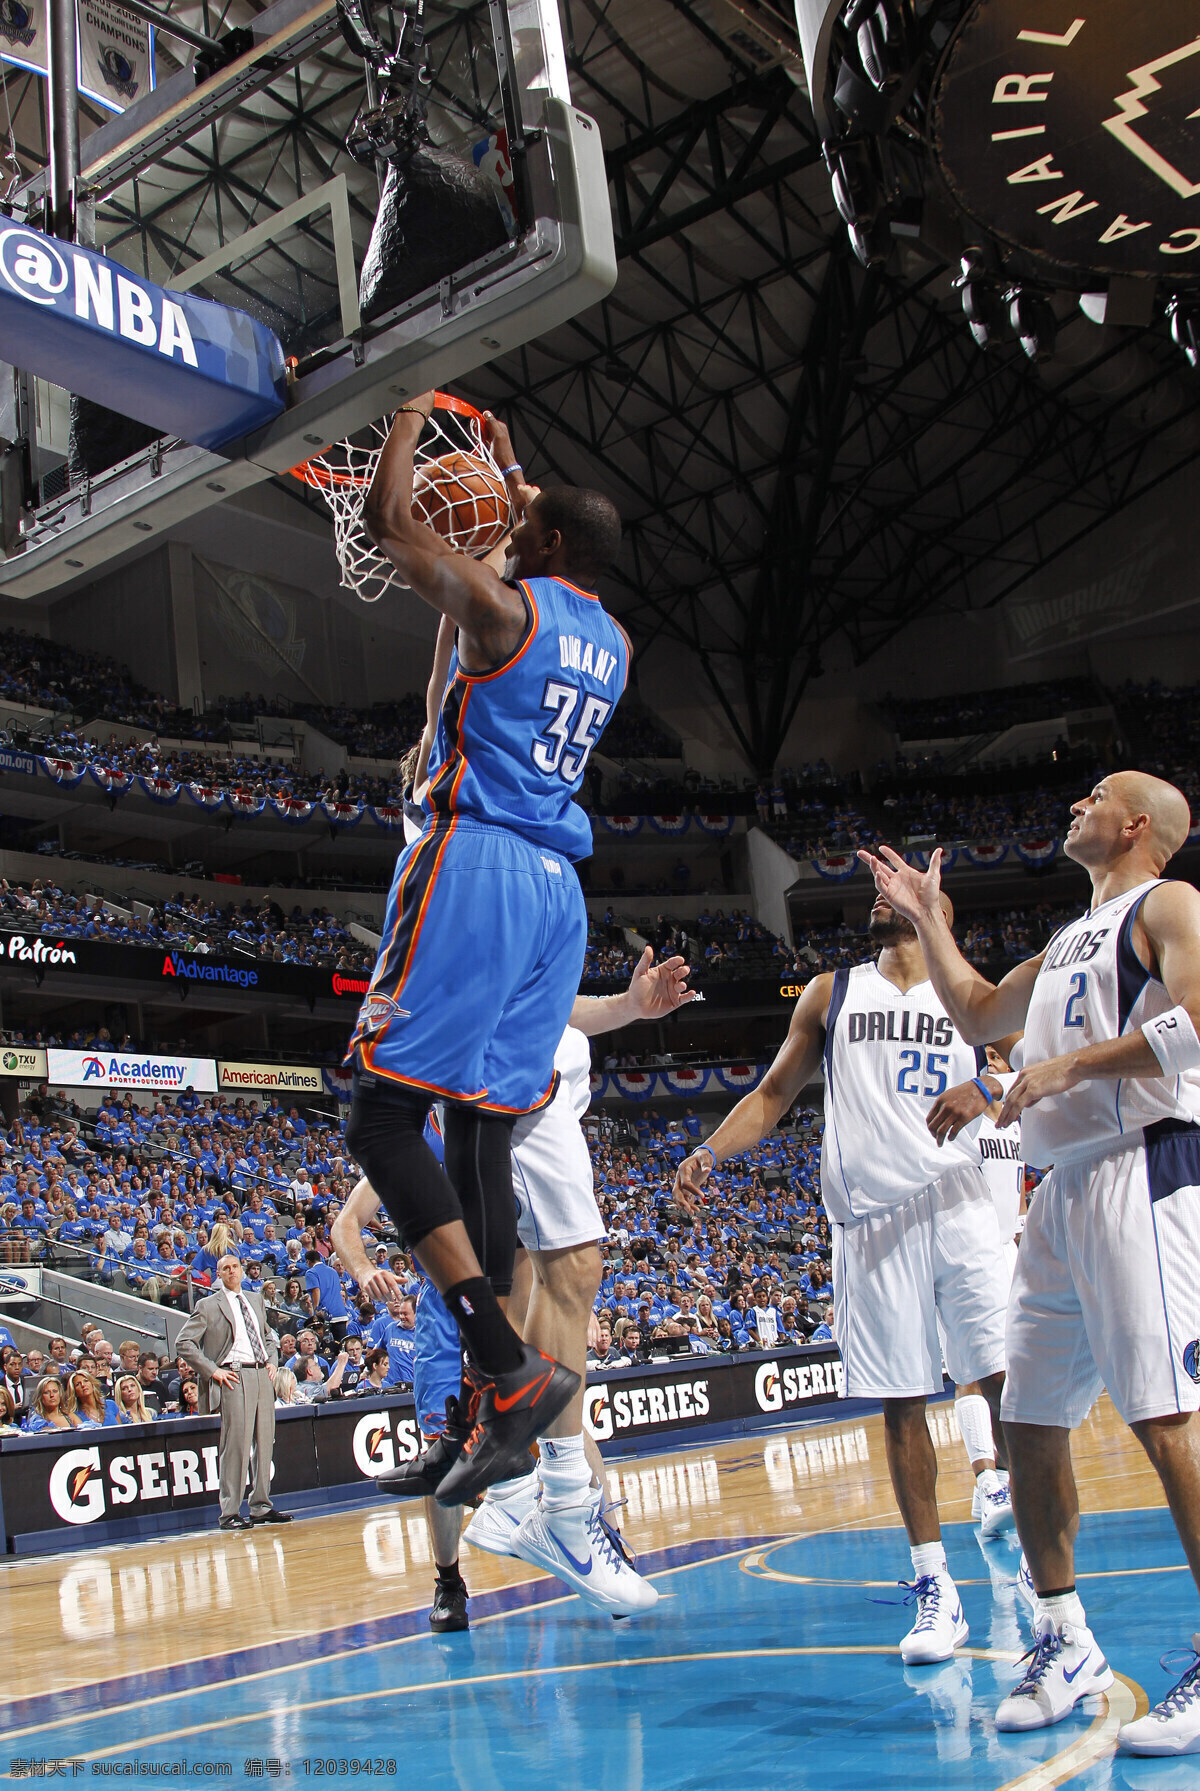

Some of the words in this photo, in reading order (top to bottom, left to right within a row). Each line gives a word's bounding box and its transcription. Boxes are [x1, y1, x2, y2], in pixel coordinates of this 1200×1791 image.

[86, 12, 146, 54] CHAMPIONS
[0, 228, 199, 368] @NBA
[558, 634, 618, 686] DURANT
[530, 678, 614, 785] 35
[8, 936, 76, 964] Patrón
[1042, 928, 1112, 974] ALLAS
[332, 973, 370, 996] Commun
[780, 985, 806, 997] CEN
[1064, 971, 1089, 1029] 2
[848, 1010, 954, 1048] DALLAS
[1155, 1017, 1177, 1034] 2
[19, 1055, 36, 1065] TXU
[108, 1058, 185, 1084] Academy
[896, 1049, 951, 1098] 25
[754, 1361, 784, 1412] G
[783, 1360, 844, 1401] SERIE
[581, 1383, 615, 1441] G
[613, 1380, 710, 1429] SERIES
[352, 1410, 395, 1478] G
[49, 1446, 106, 1525] G
[109, 1446, 275, 1505] SERI
